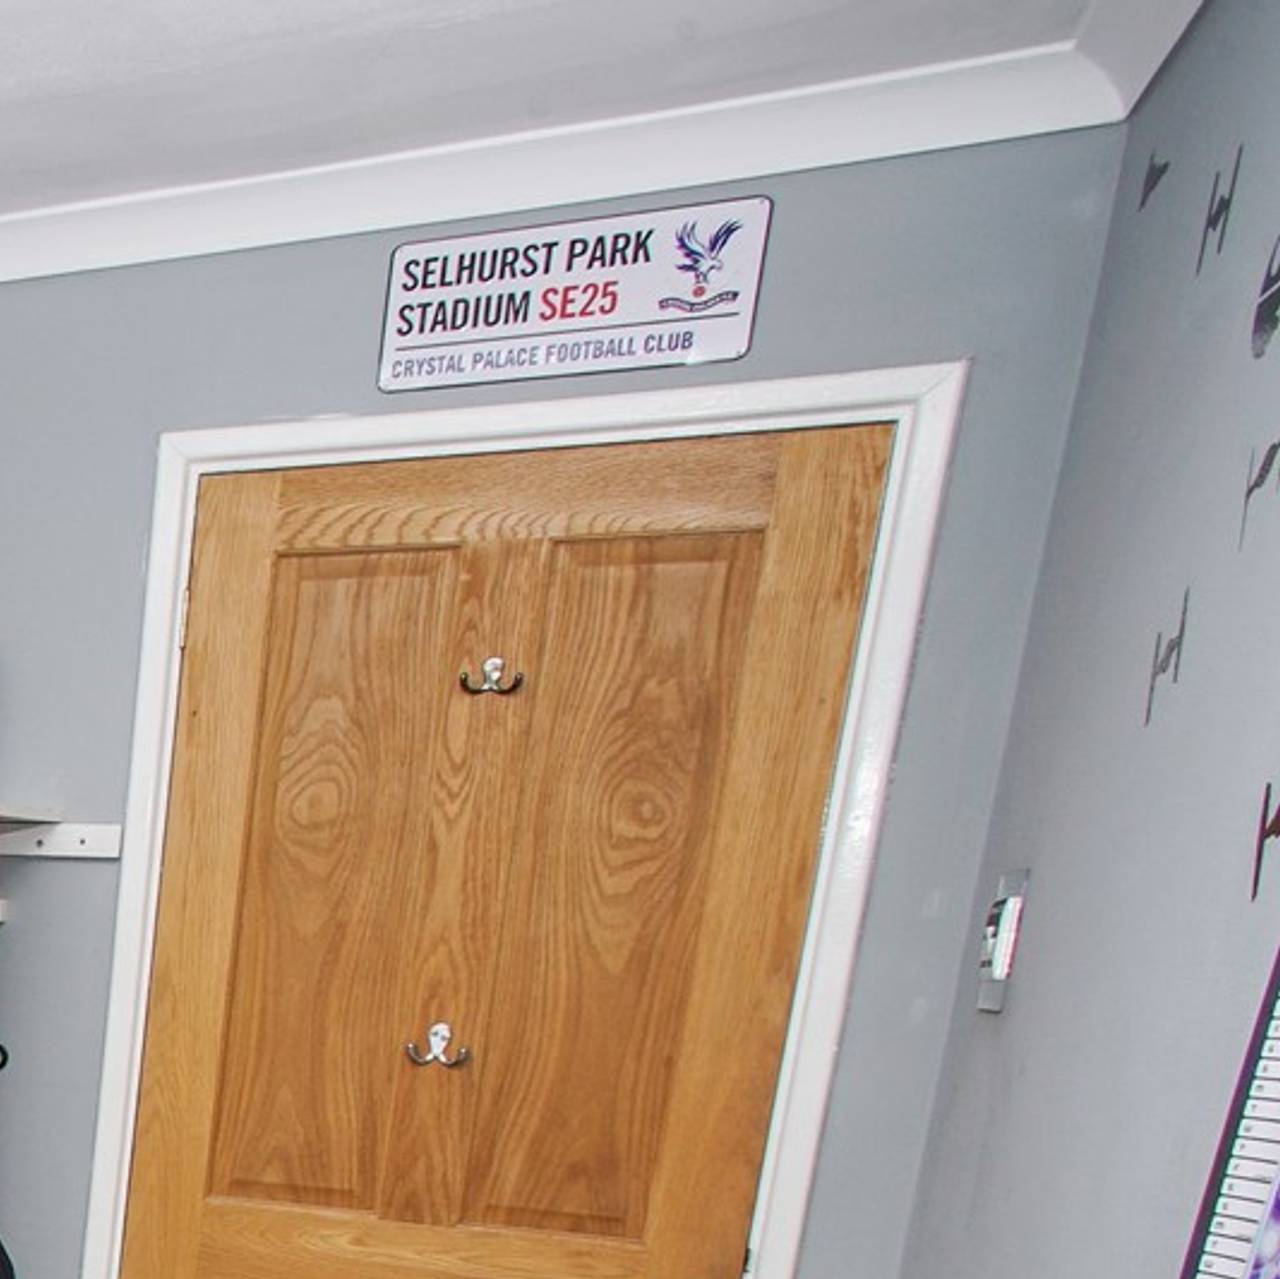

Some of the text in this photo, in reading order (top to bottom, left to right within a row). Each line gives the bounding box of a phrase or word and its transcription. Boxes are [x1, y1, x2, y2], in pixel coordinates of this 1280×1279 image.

[401, 229, 656, 292] SELHURST PARK
[396, 290, 530, 337] STADIUM
[538, 281, 619, 321] SE25
[391, 330, 695, 380] CRYSTAL PALACE FOOTBALL CLUB
